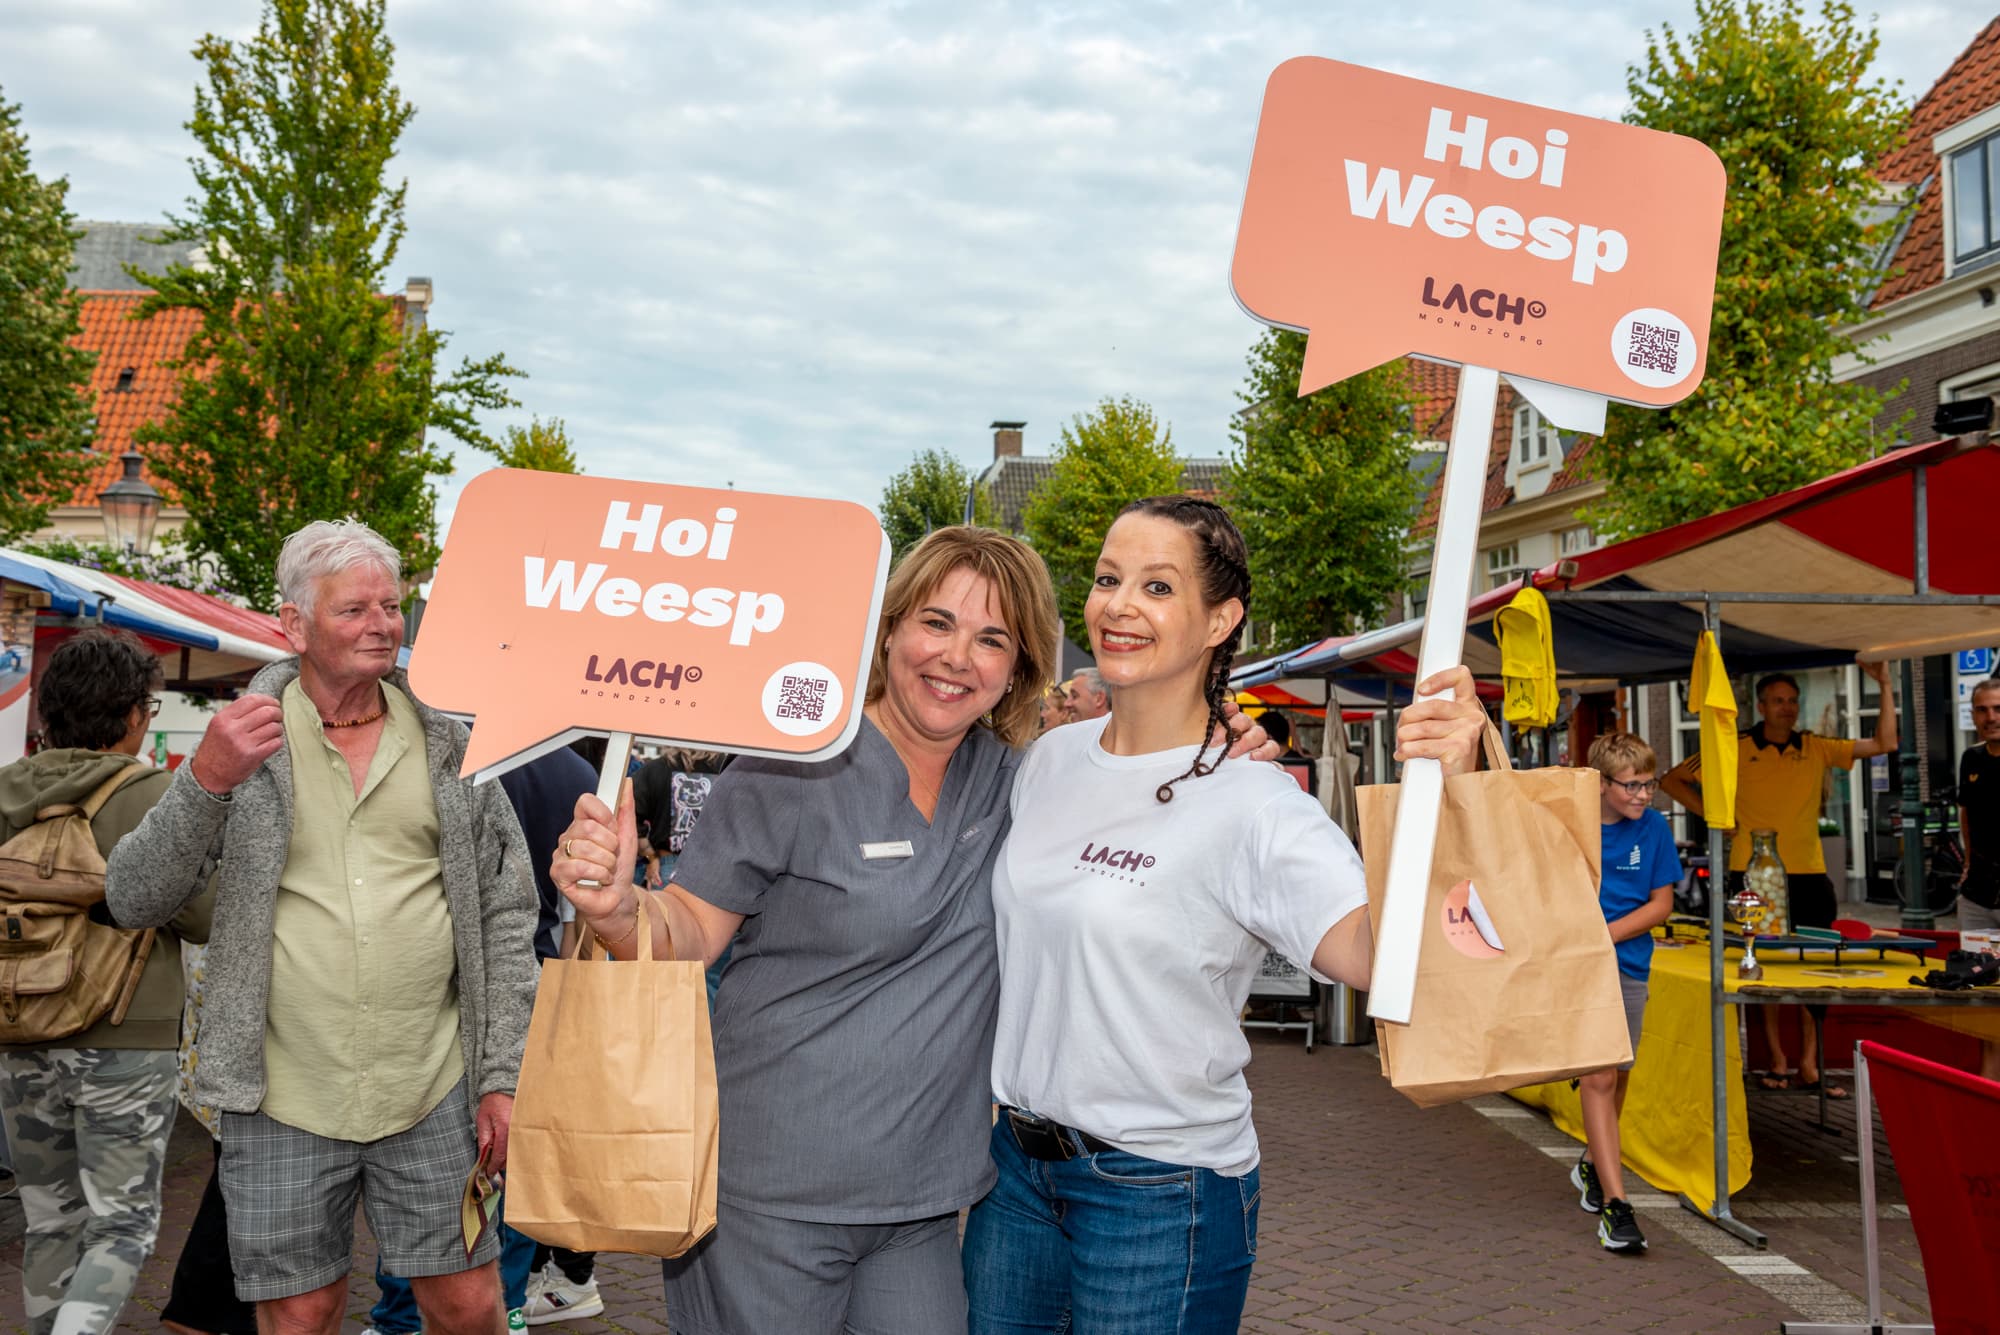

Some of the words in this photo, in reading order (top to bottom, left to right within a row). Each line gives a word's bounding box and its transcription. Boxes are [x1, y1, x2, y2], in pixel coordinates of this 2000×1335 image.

[1424, 107, 1568, 187] Hoi
[1344, 159, 1629, 285] Weesp
[1419, 313, 1543, 346] MONDZORG
[600, 500, 738, 561] Hoi
[523, 556, 785, 646] Weesp
[580, 689, 698, 708] MONDZORG
